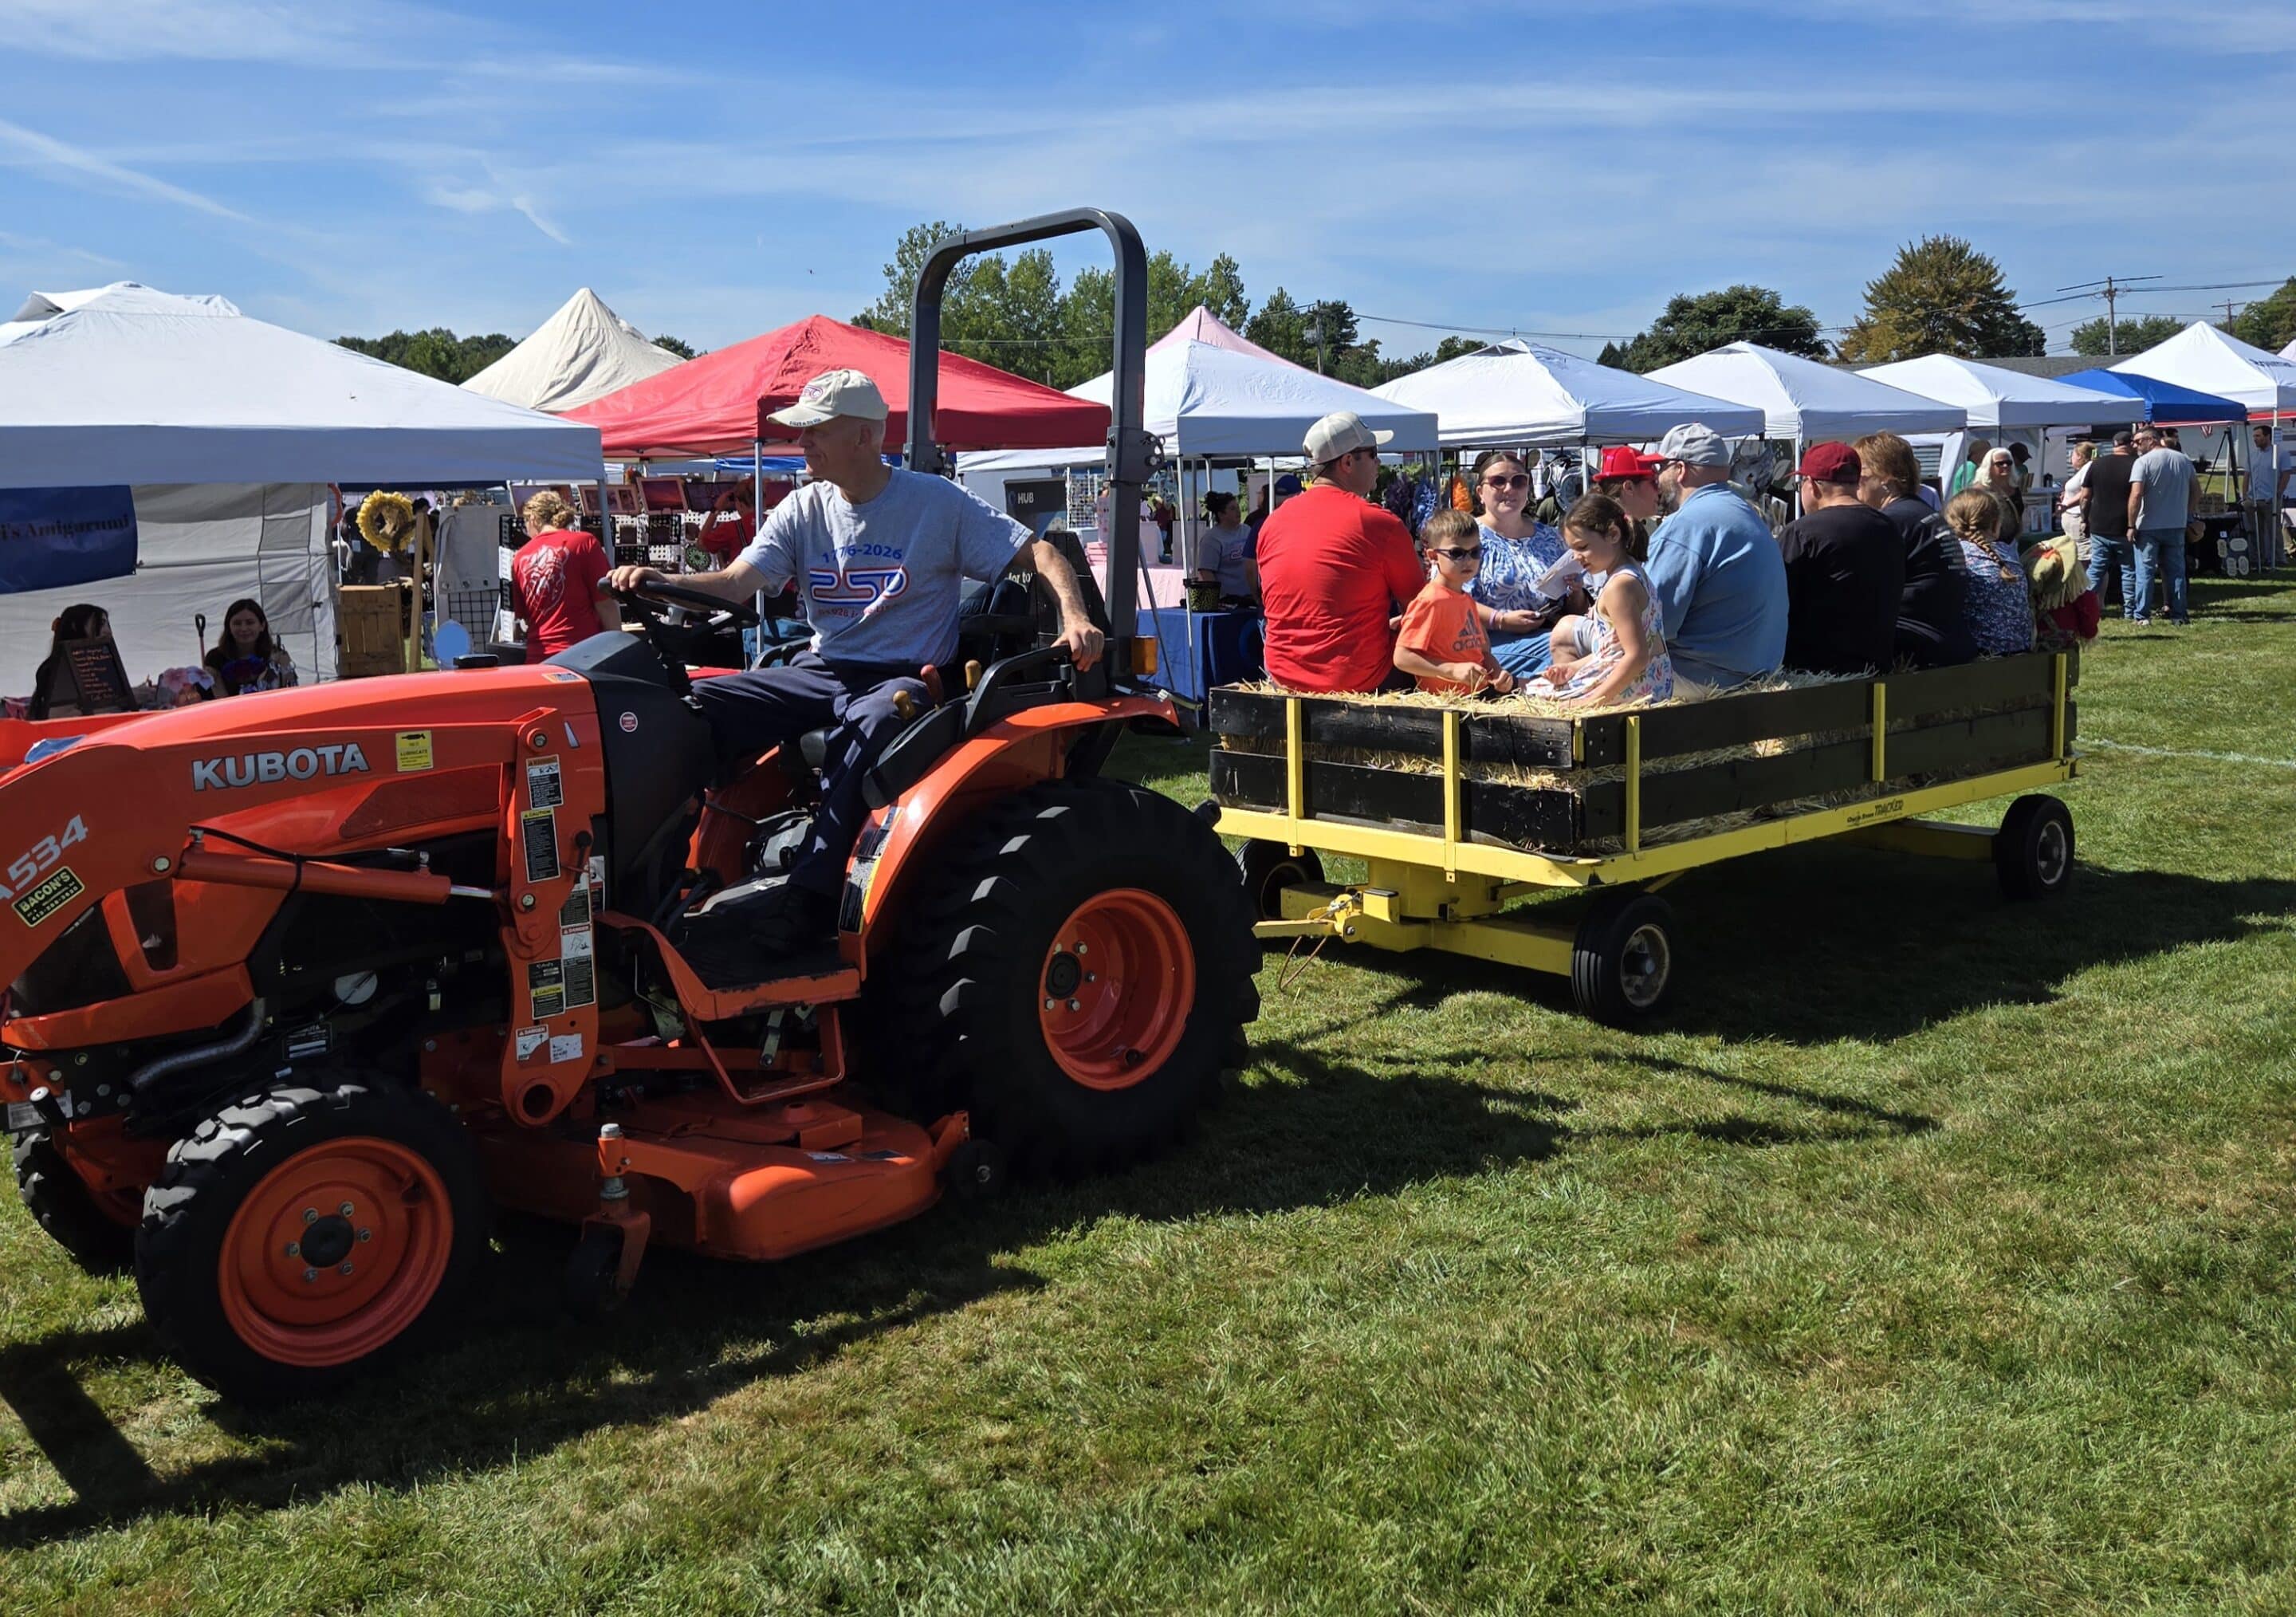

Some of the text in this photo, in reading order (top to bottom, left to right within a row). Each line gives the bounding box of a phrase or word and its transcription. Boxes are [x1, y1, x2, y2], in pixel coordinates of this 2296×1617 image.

[1017, 492, 1035, 504] HUB
[822, 543, 902, 563] 1776-2026
[809, 565, 910, 604] 250
[192, 742, 370, 792] KUBOTA
[529, 809, 552, 818] CAUTION
[18, 871, 71, 913] BACON'S
